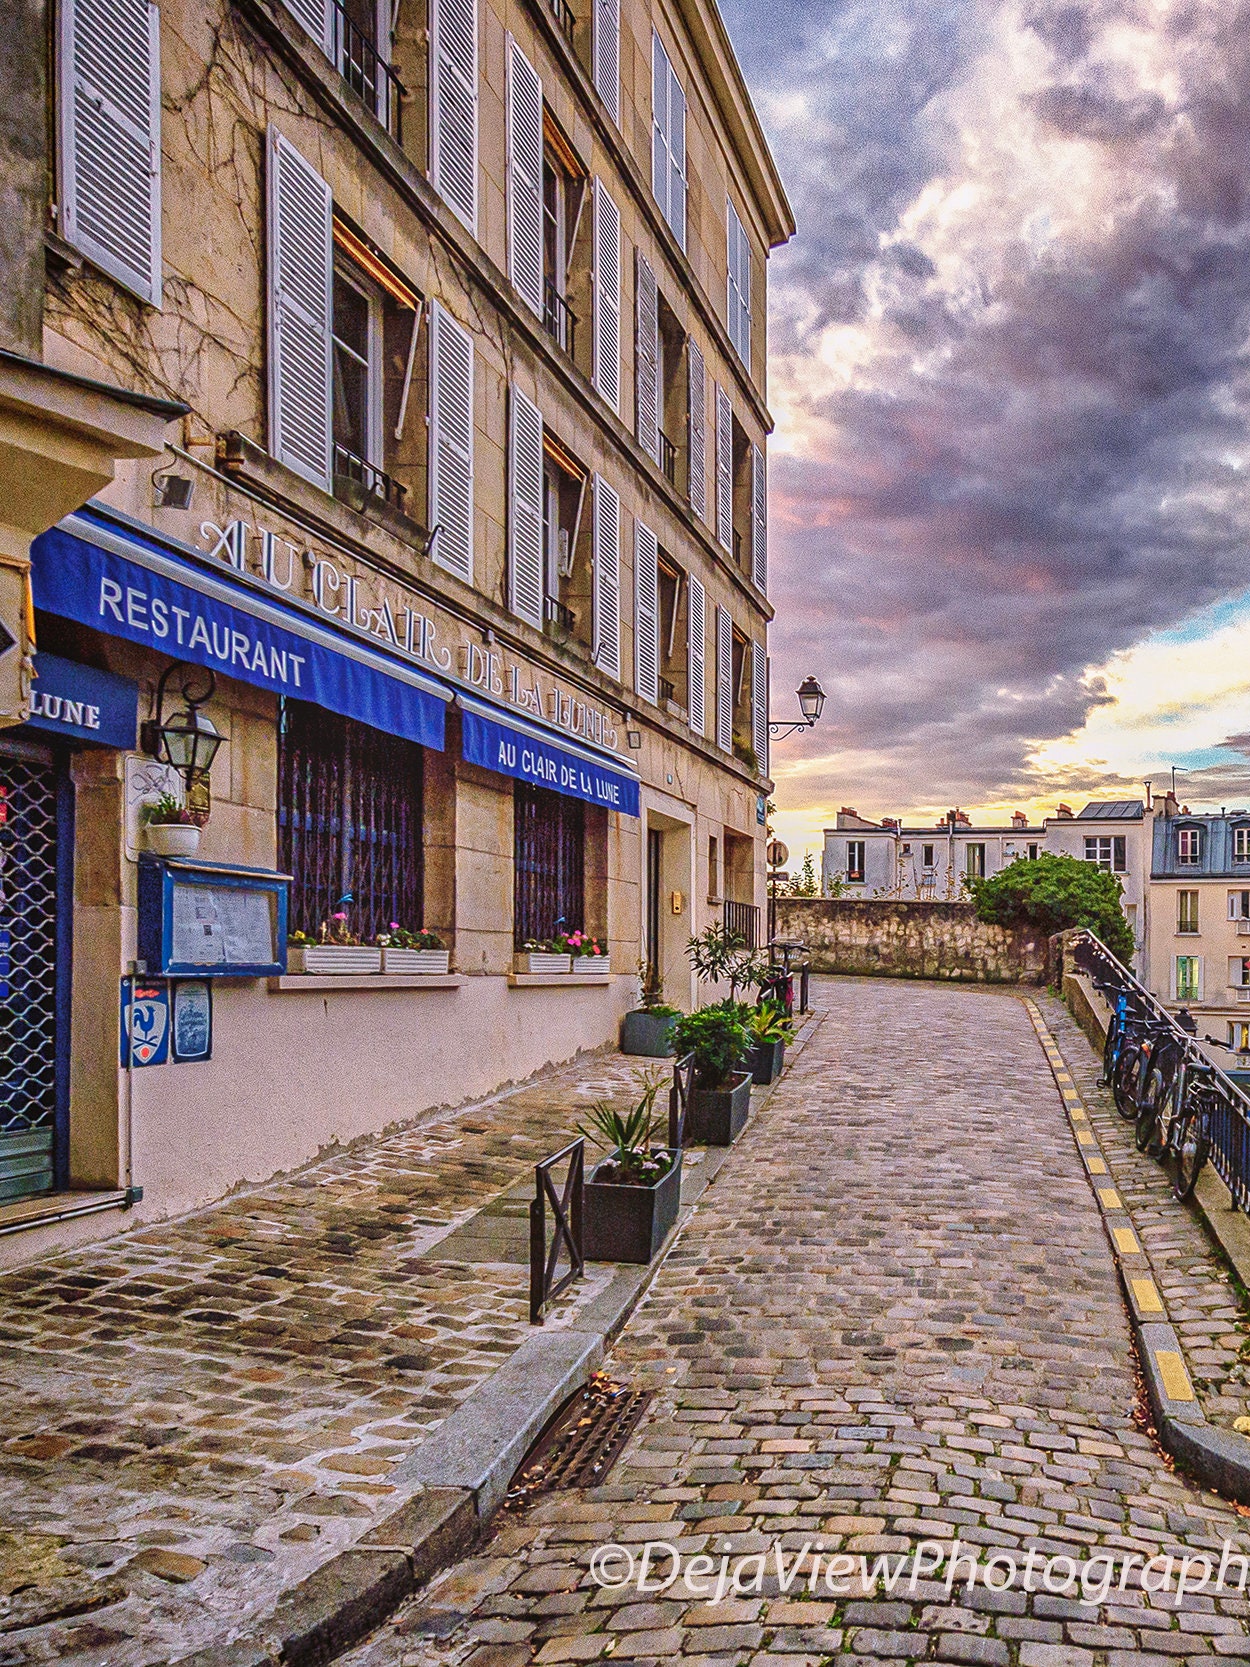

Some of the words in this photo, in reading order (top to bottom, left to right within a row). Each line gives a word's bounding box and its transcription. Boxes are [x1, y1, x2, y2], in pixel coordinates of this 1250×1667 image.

[100, 576, 305, 687] RESTAURANT
[195, 520, 300, 590] AU
[312, 560, 451, 671] CLAIR
[464, 639, 503, 695] DE
[510, 664, 546, 719] LA
[551, 687, 618, 750] LUNE
[30, 689, 100, 730] LUNE
[498, 740, 516, 768] AU
[521, 749, 558, 784] CLAIR
[560, 764, 577, 789] DE
[580, 771, 593, 796] LA
[596, 777, 620, 805] LUNE
